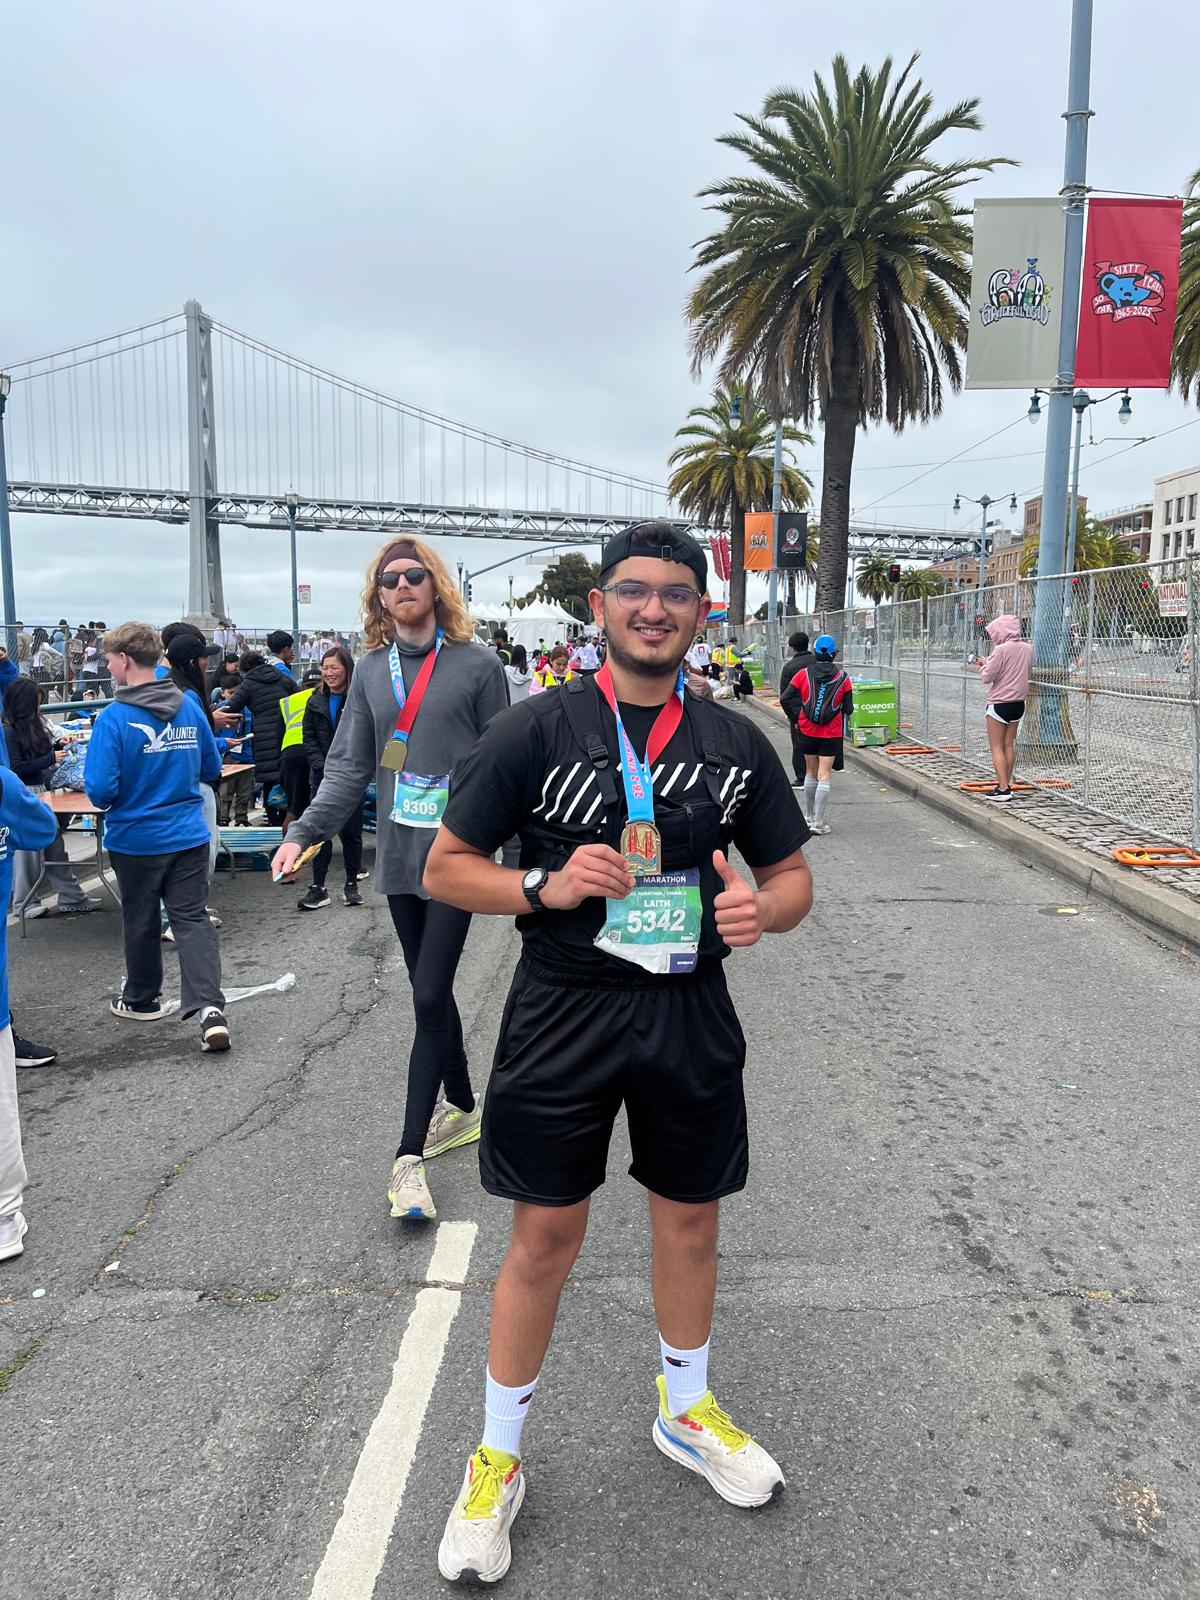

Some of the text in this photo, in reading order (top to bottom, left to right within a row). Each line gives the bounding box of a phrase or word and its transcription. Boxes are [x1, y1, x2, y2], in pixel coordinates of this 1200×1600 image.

[1113, 264, 1140, 275] SIXTY
[1142, 274, 1163, 293] YEARS
[1094, 294, 1105, 306] SO
[1096, 304, 1114, 314] FAR
[980, 303, 1025, 326] GRATEFUL
[1115, 306, 1153, 319] 1965-2025
[1159, 582, 1189, 600] NATIONAL
[813, 686, 826, 722] NATHAN
[632, 775, 645, 799] 26.2
[403, 798, 438, 816] 9309
[644, 899, 671, 907] LAITH
[627, 909, 686, 933] 5342
[478, 1448, 491, 1466] HOK
